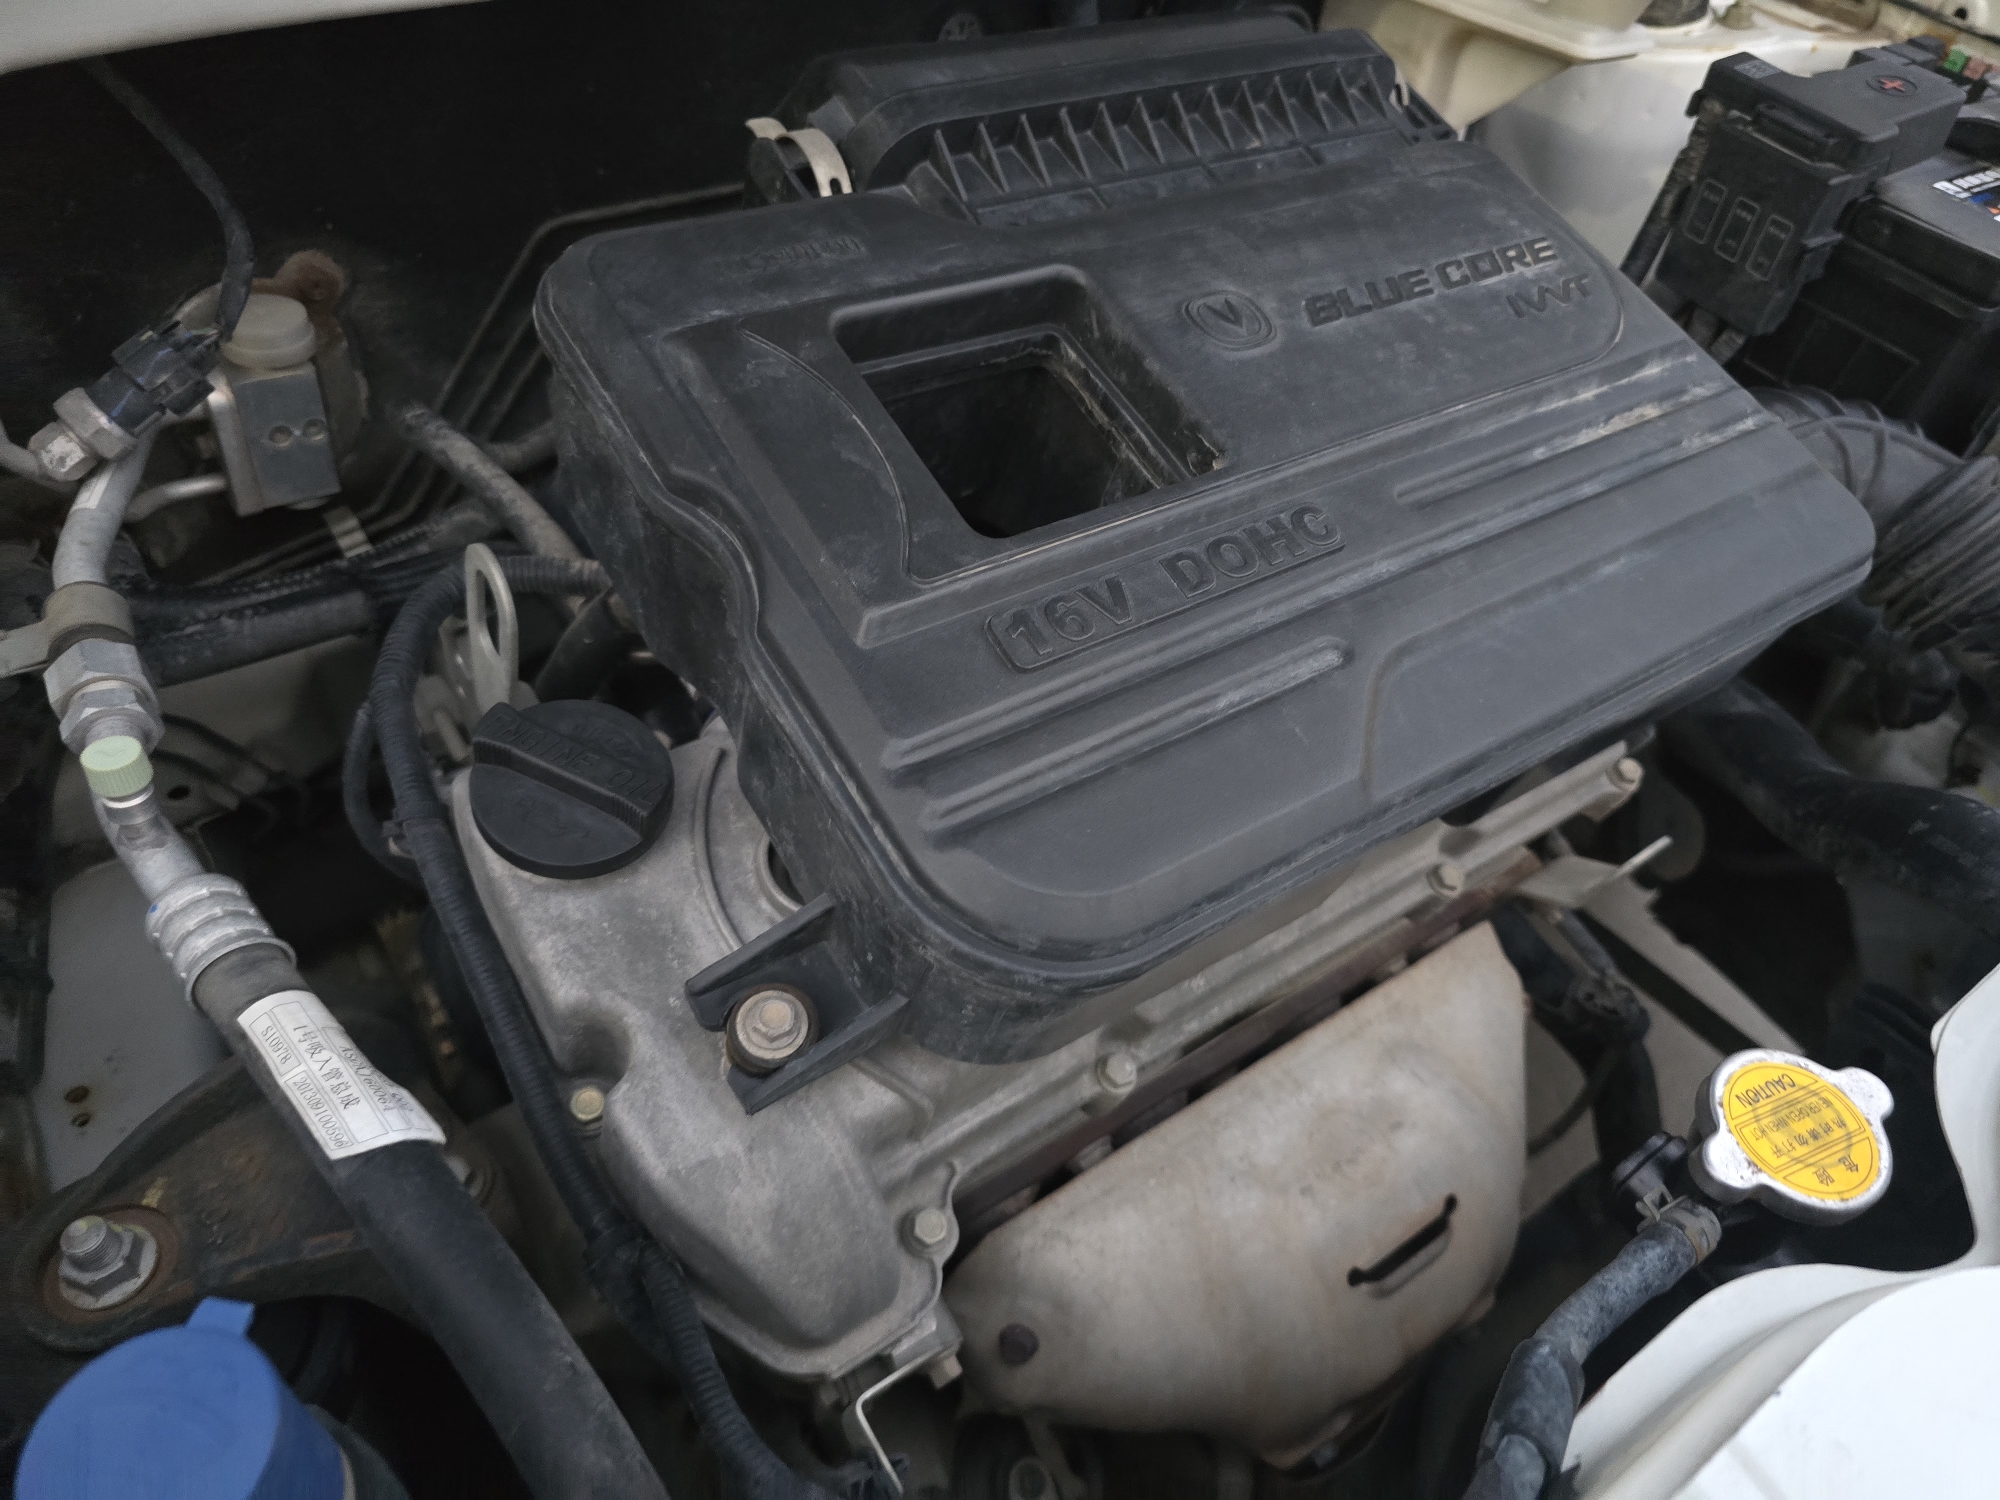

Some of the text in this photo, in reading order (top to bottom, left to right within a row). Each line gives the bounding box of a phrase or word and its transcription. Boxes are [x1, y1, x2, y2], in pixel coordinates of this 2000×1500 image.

[1304, 236, 1558, 328] BLUE CORE
[1006, 503, 1343, 656] 16V DOHC
[607, 768, 663, 807] OIL
[260, 1024, 292, 1065] S10978
[1735, 1073, 1796, 1109] CAUTION
[1749, 1095, 1833, 1141] NEVER OPEN WHEN HOT
[1811, 1155, 1859, 1187] 危险
